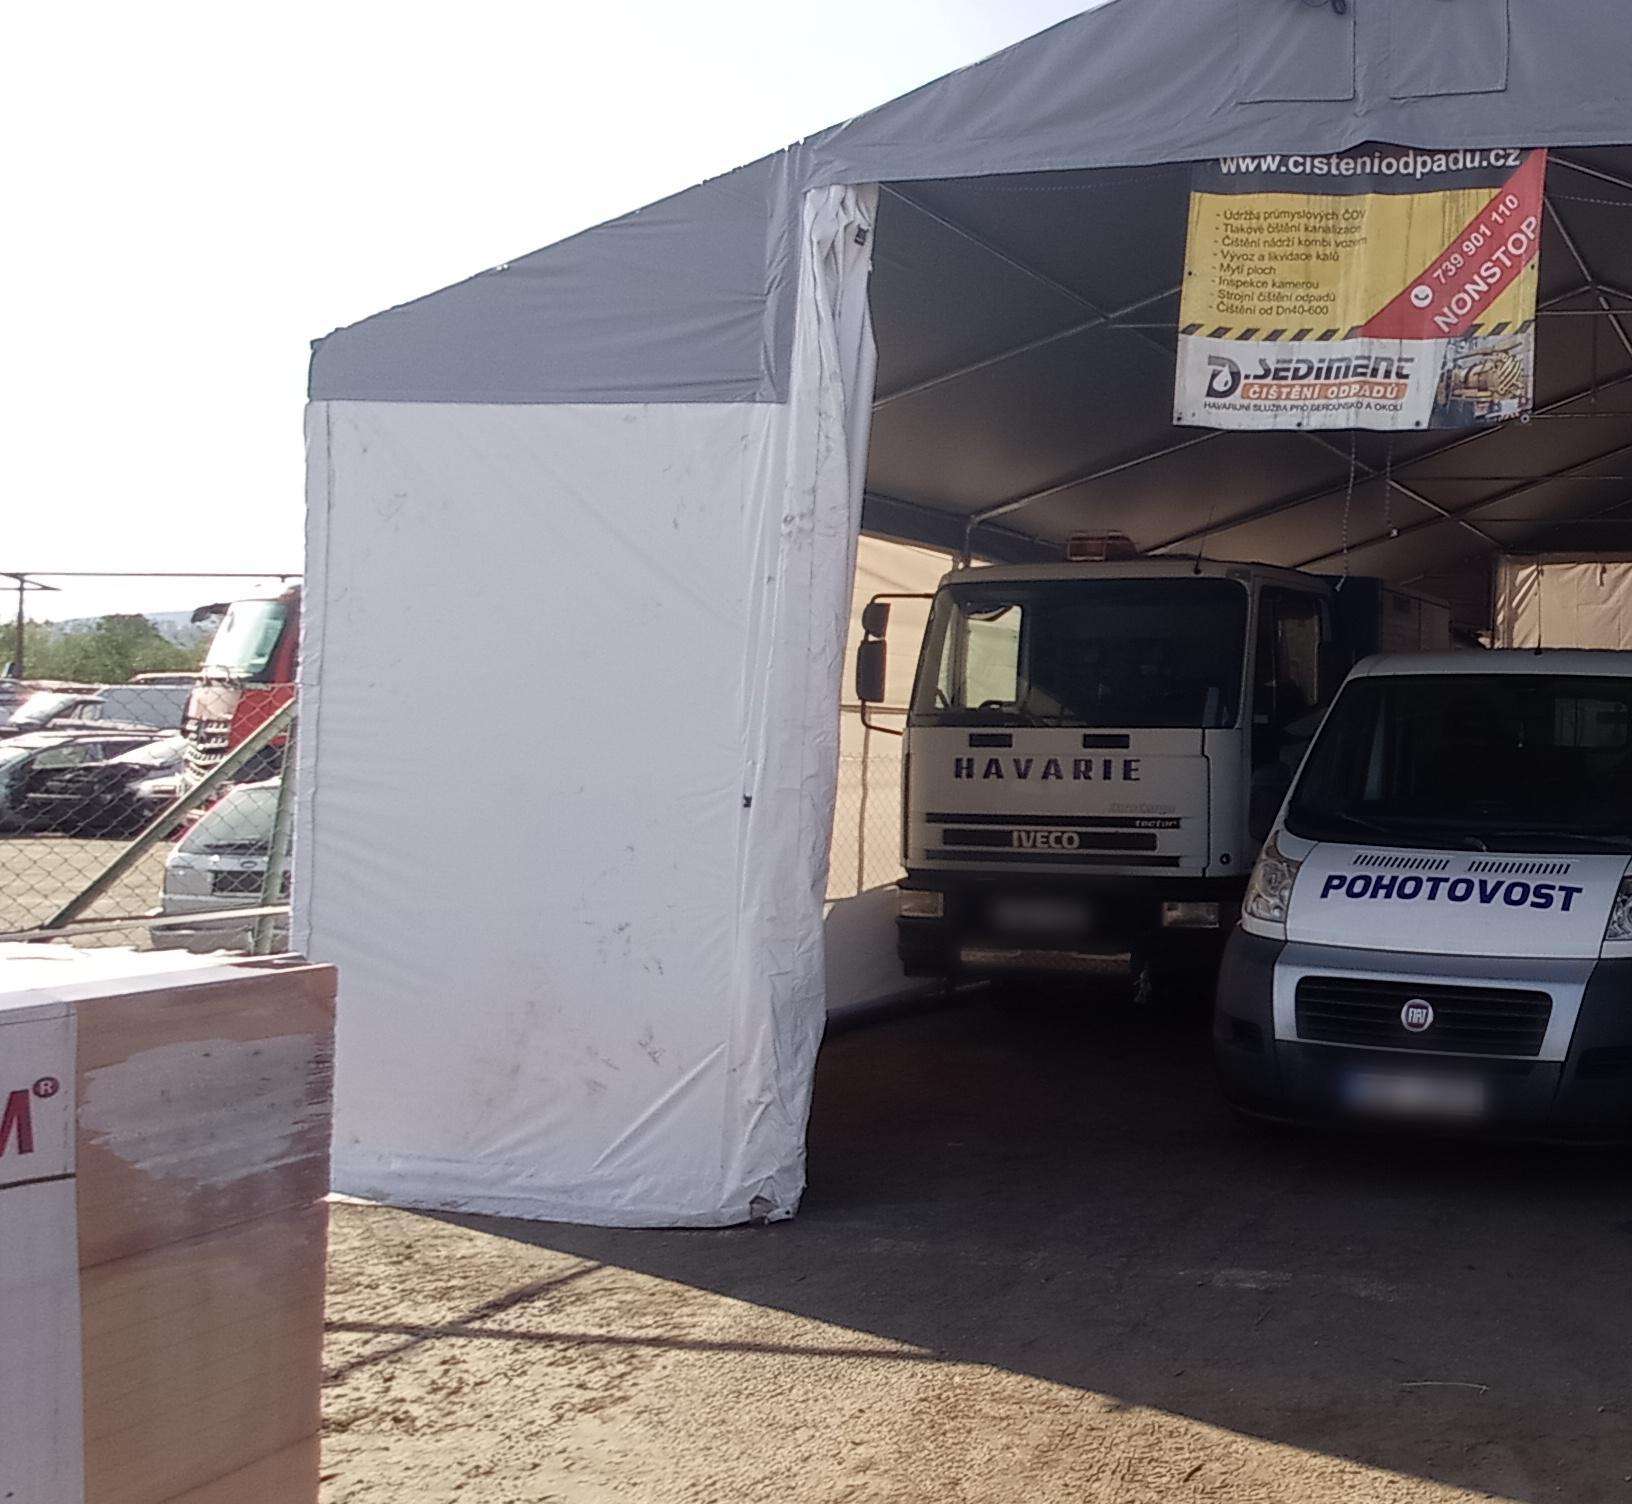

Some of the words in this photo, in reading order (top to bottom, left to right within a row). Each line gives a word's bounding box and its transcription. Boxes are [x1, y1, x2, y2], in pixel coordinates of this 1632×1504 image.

[1263, 209, 1339, 222] průmyslových
[1223, 223, 1265, 234] Tlakové
[1266, 223, 1301, 234] čištění
[1221, 235, 1261, 248] Čištění
[1297, 237, 1332, 247] kombi
[1433, 255, 1464, 285] 739
[1462, 226, 1492, 256] 901
[1491, 194, 1520, 224] 110
[1220, 249, 1256, 262] Vývoz
[1257, 253, 1265, 261] a
[1268, 251, 1313, 262] likvidace
[1315, 250, 1340, 262] kalů
[1219, 262, 1244, 275] Mytí
[1247, 265, 1277, 276] ploch
[1433, 216, 1539, 334] NONSTOP
[1218, 276, 1268, 290] Inspekce
[1271, 278, 1319, 290] kamerou
[1217, 289, 1255, 303] Strojní
[1257, 290, 1293, 303] čištění
[1295, 292, 1336, 303] odpadů
[1216, 301, 1256, 315] Čištění
[1258, 304, 1273, 315] od
[1249, 384, 1320, 399] ČIŠTĚNÍ
[1327, 382, 1399, 399] ODPADŮ
[953, 757, 1142, 781] HAVARIE
[1011, 831, 1081, 850] IVECO
[1319, 873, 1584, 912] POHOTOVOST
[1407, 1007, 1428, 1024] FIAT
